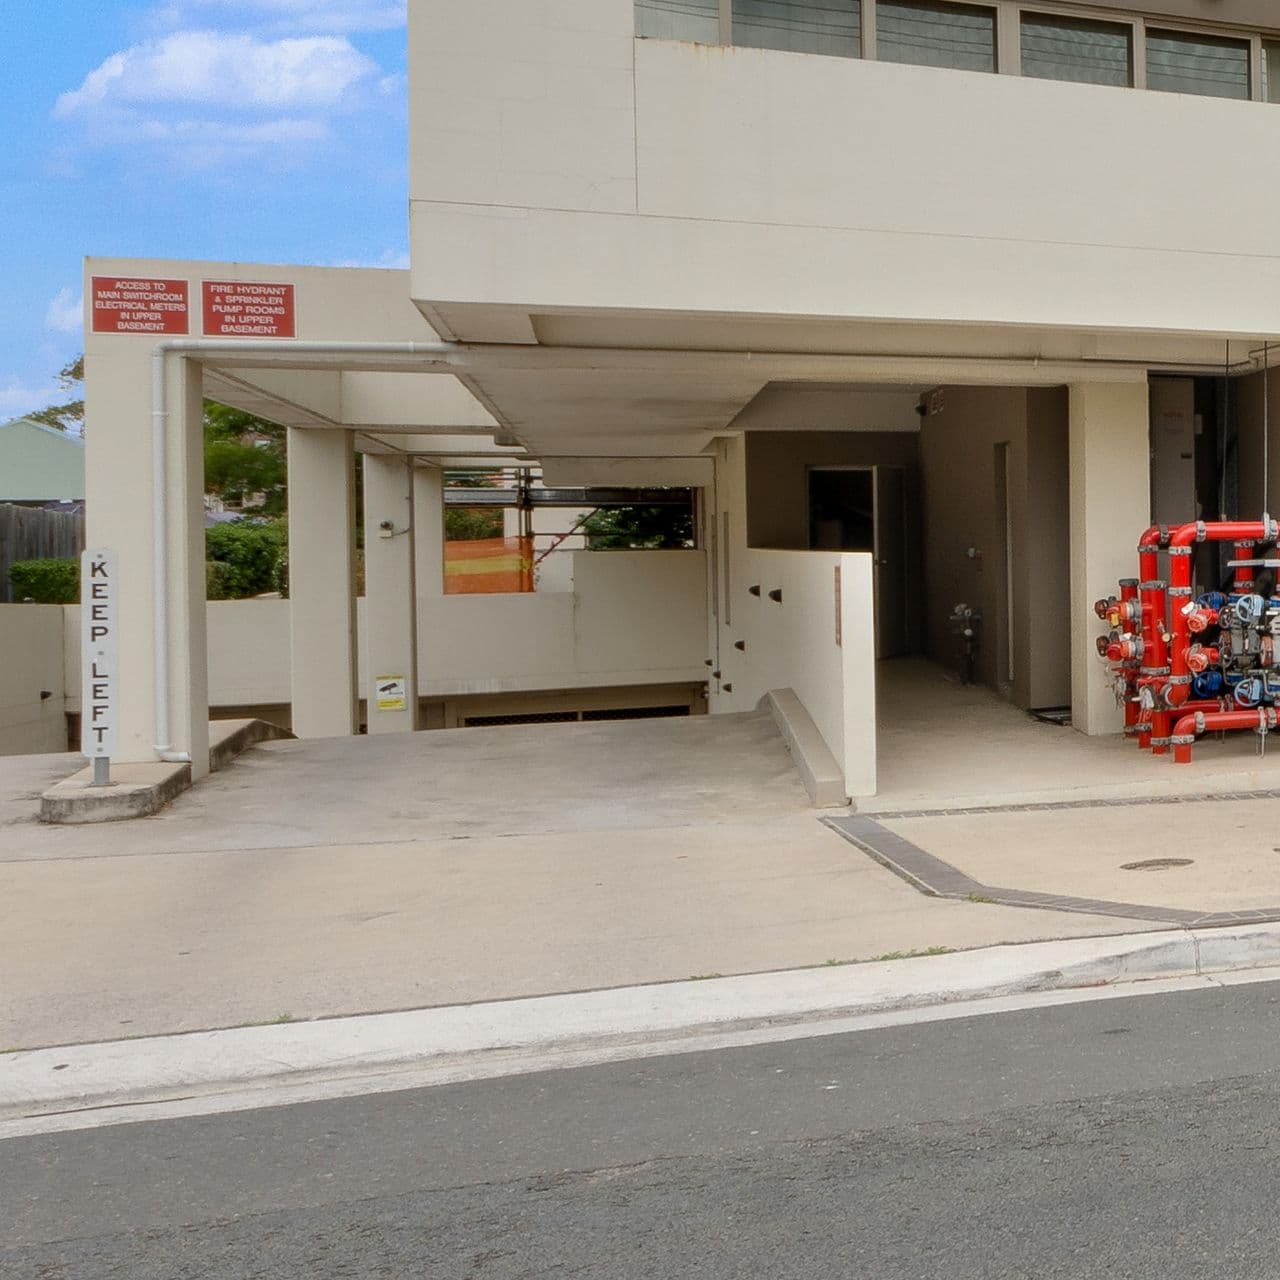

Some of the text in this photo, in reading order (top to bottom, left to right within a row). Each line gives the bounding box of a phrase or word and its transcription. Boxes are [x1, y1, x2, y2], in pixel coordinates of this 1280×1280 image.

[115, 281, 166, 291] ACCESS TO
[210, 285, 286, 295] FIRE HYDRANT
[97, 291, 183, 301] MAIN SWITCHROOM
[225, 295, 283, 305] SPRINKLER
[95, 301, 186, 312] ELECTRICAL METERS
[212, 304, 285, 315] PUMP ROOMS
[120, 311, 162, 320] IN UPPER
[224, 315, 274, 324] IN UPPER
[117, 322, 165, 330] BASEMENT
[221, 325, 278, 334] BASEMENT
[91, 561, 109, 743] KEEP LEFT
